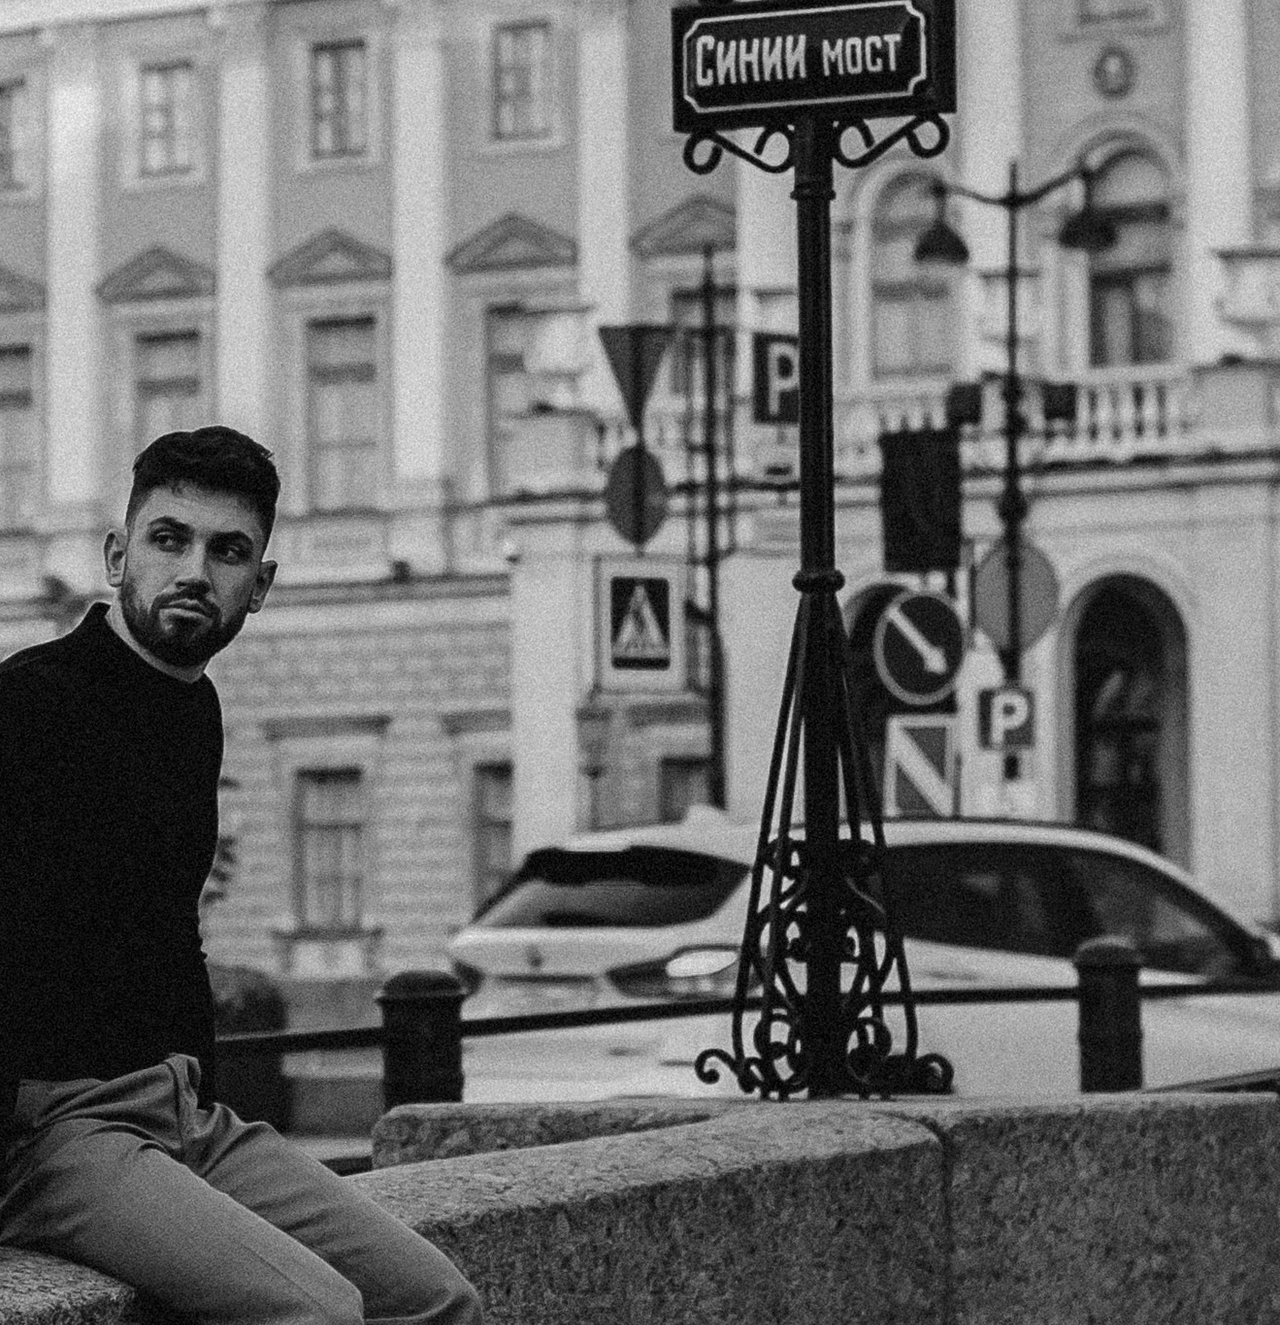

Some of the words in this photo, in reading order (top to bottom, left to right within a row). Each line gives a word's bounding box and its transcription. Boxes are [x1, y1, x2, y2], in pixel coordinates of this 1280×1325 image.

[822, 33, 901, 76] МОСТ
[769, 342, 800, 415] P
[991, 693, 1028, 744] P
